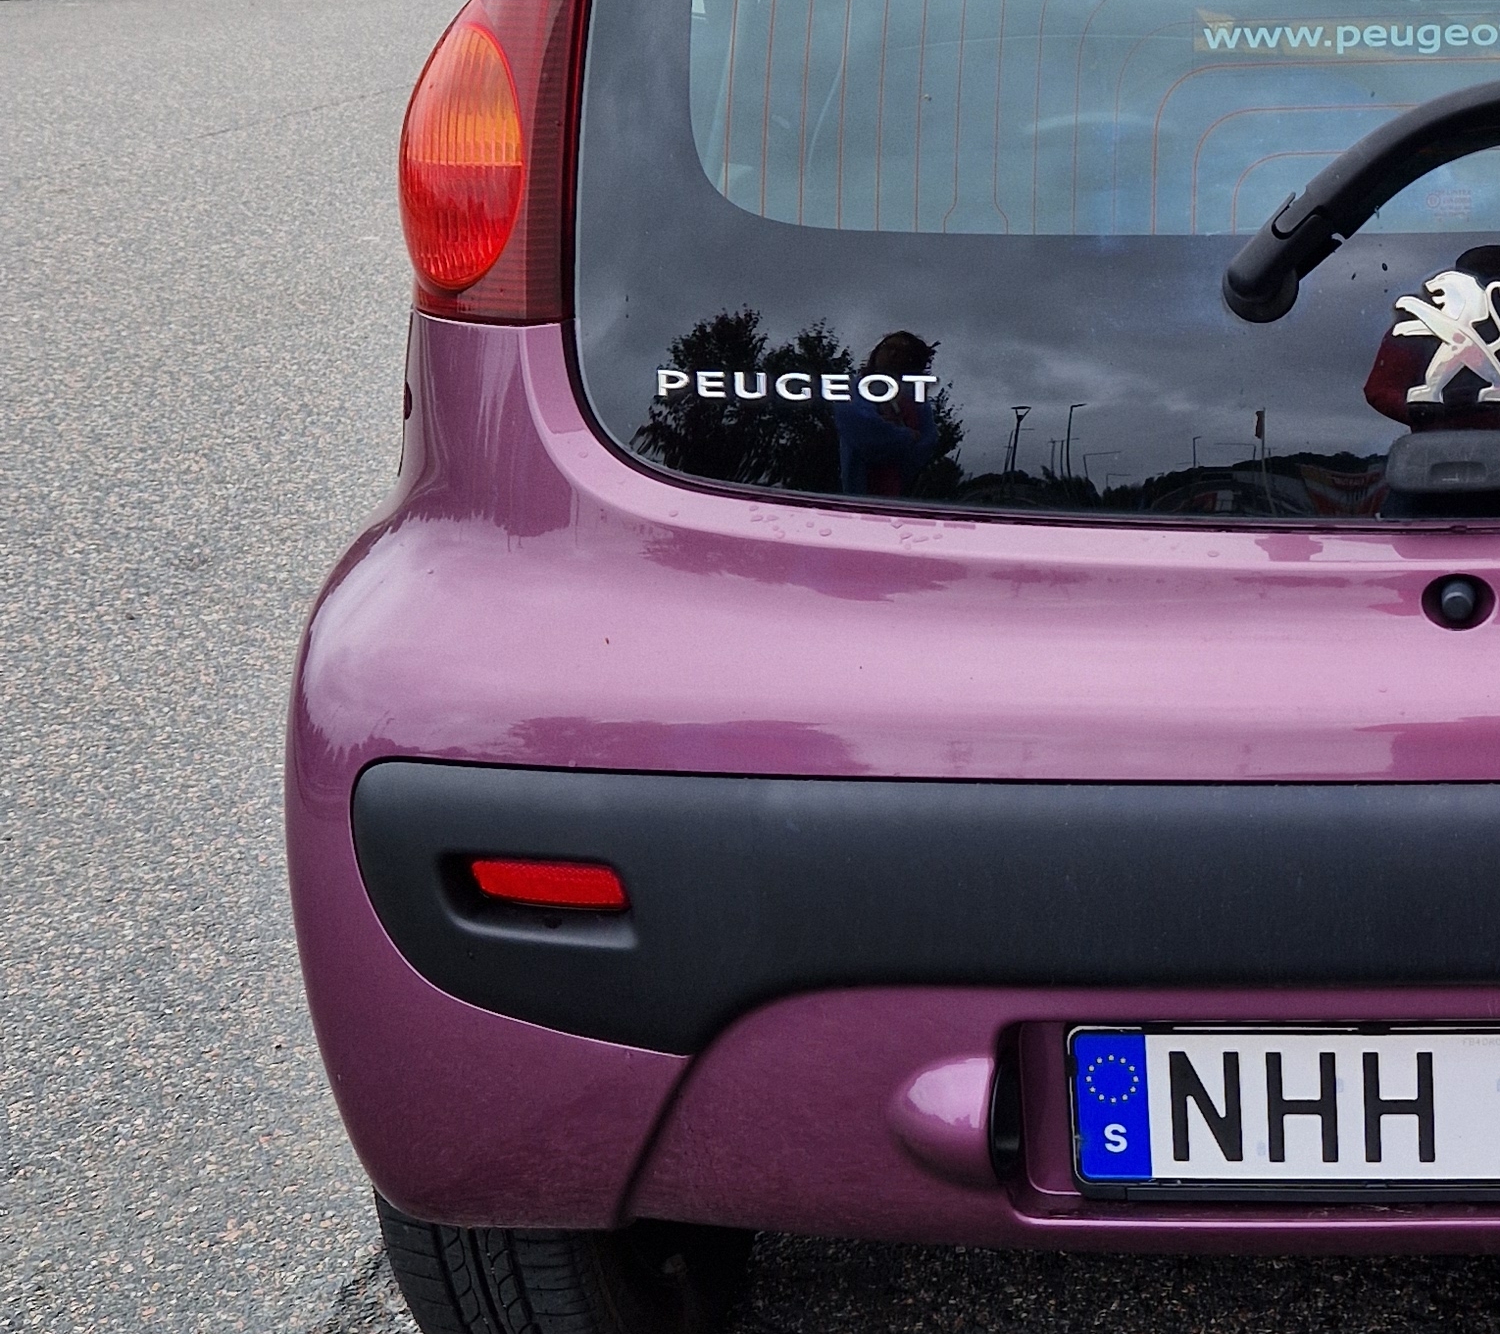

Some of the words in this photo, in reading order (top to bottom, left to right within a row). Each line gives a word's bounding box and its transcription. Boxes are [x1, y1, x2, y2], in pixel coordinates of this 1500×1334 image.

[657, 369, 938, 403] PEUGEOT
[1168, 1050, 1436, 1163] NHH
[1104, 1123, 1128, 1153] S
